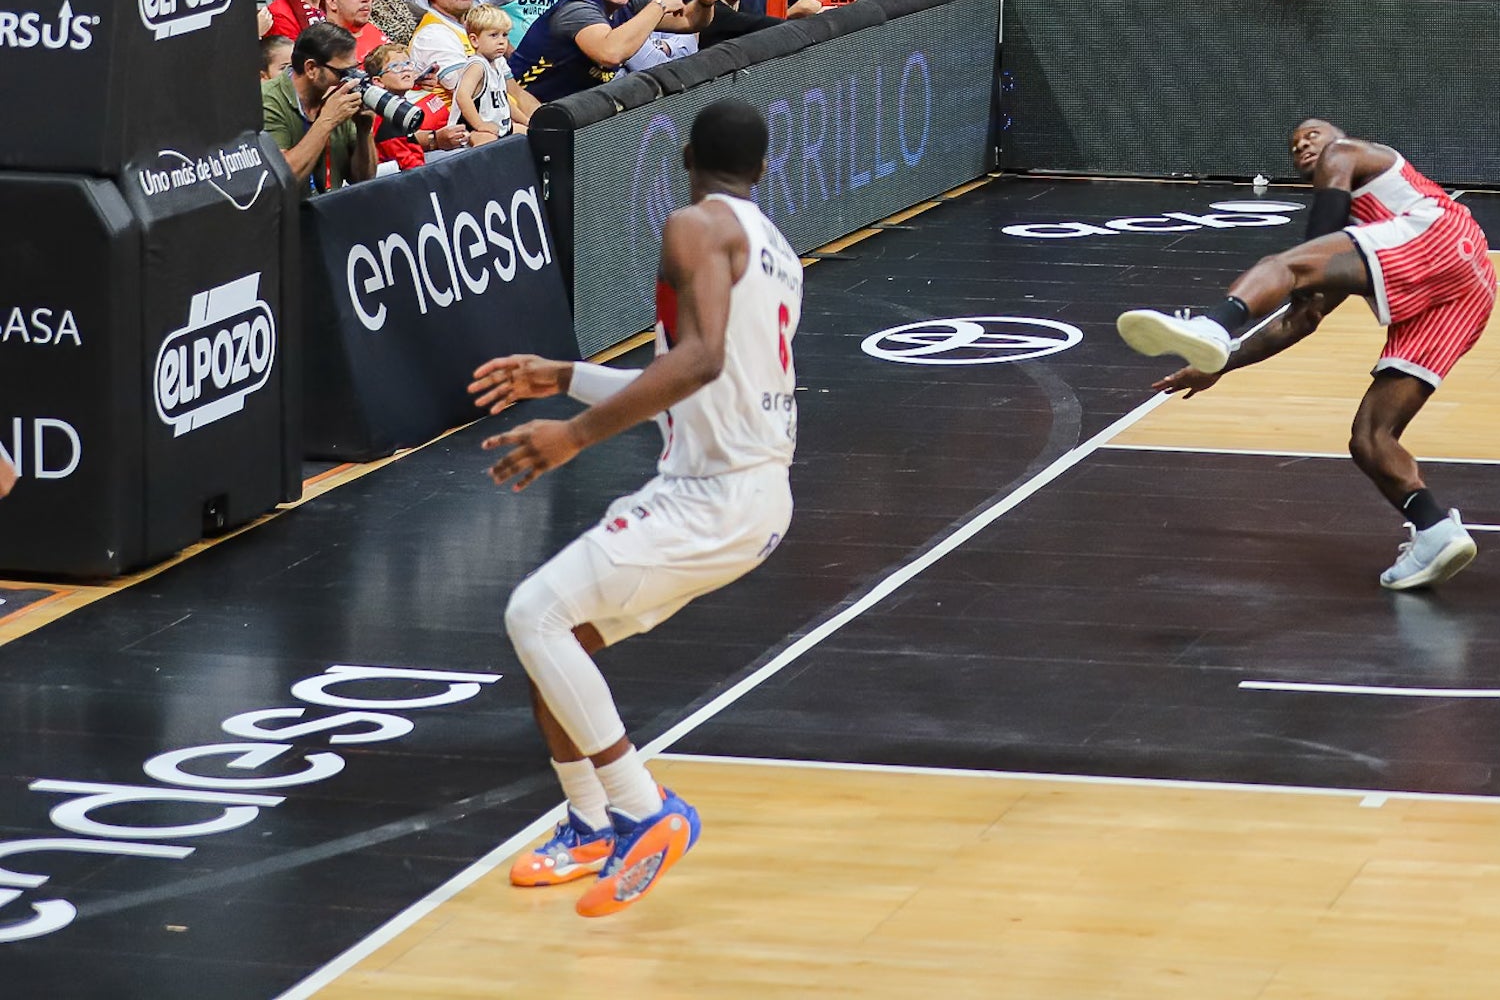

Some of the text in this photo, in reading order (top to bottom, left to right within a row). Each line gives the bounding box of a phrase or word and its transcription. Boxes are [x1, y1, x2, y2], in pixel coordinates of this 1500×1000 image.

[139, 143, 262, 197] Uno más de la familia
[1002, 210, 1292, 239] acb
[345, 184, 552, 332] endesa
[0, 306, 83, 347] ASA
[777, 302, 793, 375] 6
